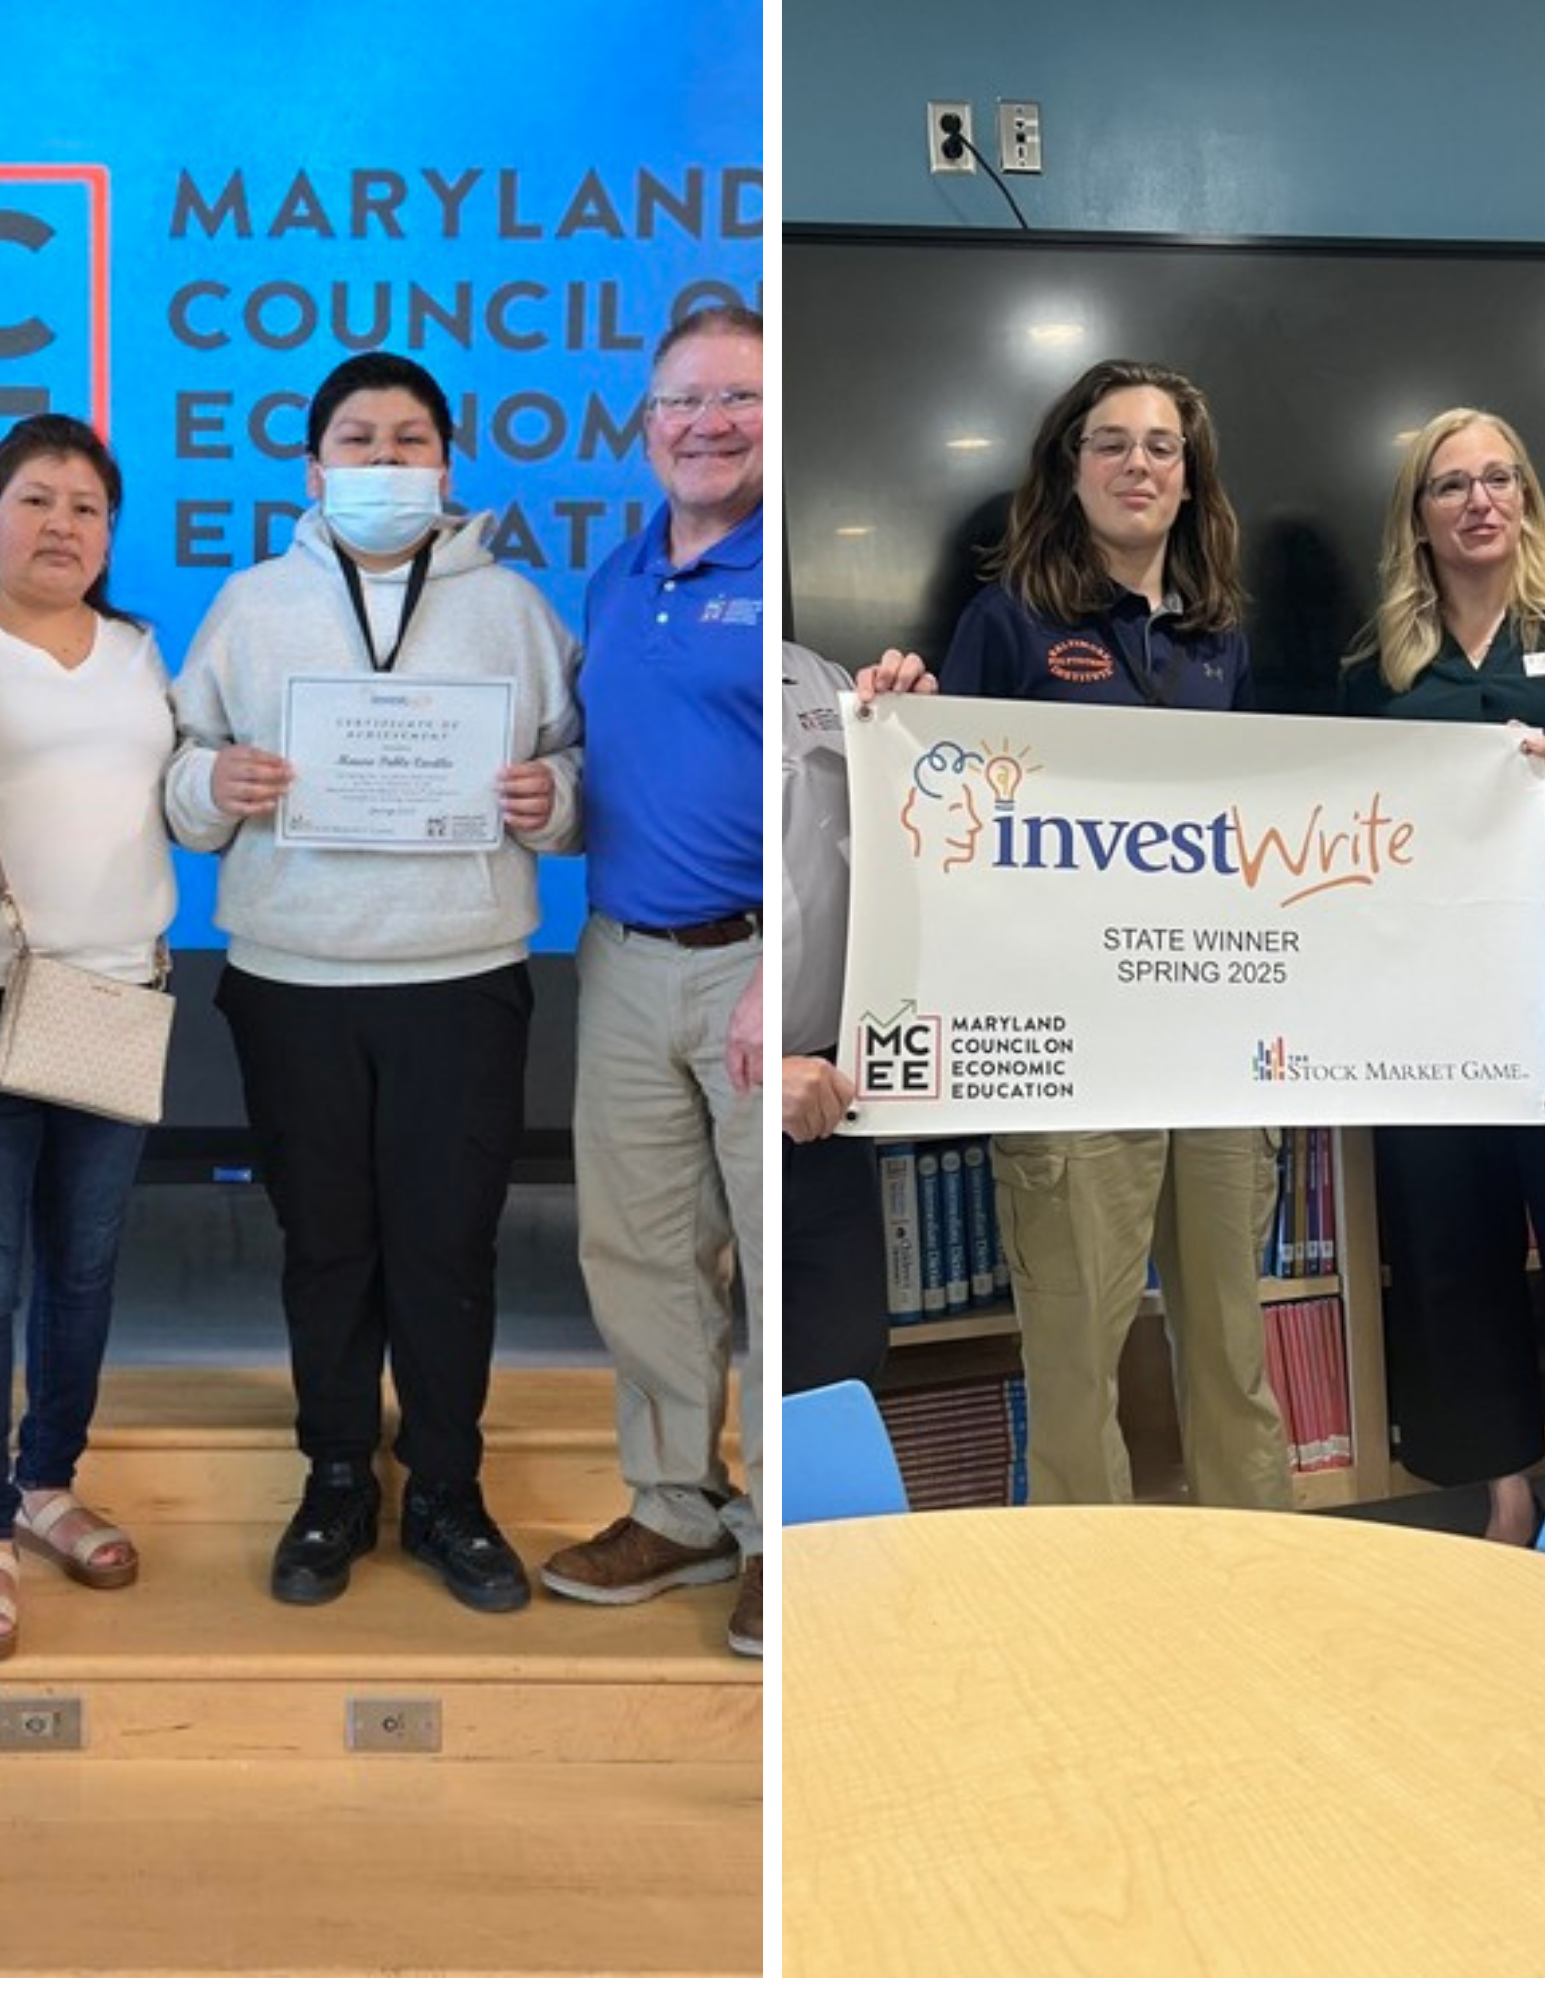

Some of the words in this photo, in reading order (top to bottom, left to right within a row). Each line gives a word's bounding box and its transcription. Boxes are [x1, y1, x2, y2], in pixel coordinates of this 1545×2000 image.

[168, 167, 763, 239] MARYLAND
[167, 280, 643, 351] COUNCIL
[992, 792, 1415, 889] investWrite
[1103, 928, 1185, 951] STATE
[1193, 929, 1300, 953] WINNER
[1117, 960, 1221, 984] SPRING
[1228, 961, 1288, 984] 2025
[951, 1015, 1067, 1033] MARYLAND
[866, 1025, 931, 1056] MC
[950, 1037, 1041, 1054] COUNCIL
[1043, 1037, 1074, 1054] ON
[866, 1060, 929, 1091] EE
[951, 1060, 1066, 1077] ECONOMIC
[1287, 1061, 1358, 1081] STOCK
[1365, 1061, 1457, 1081] MARKET
[951, 1082, 1074, 1099] EDUCATION
